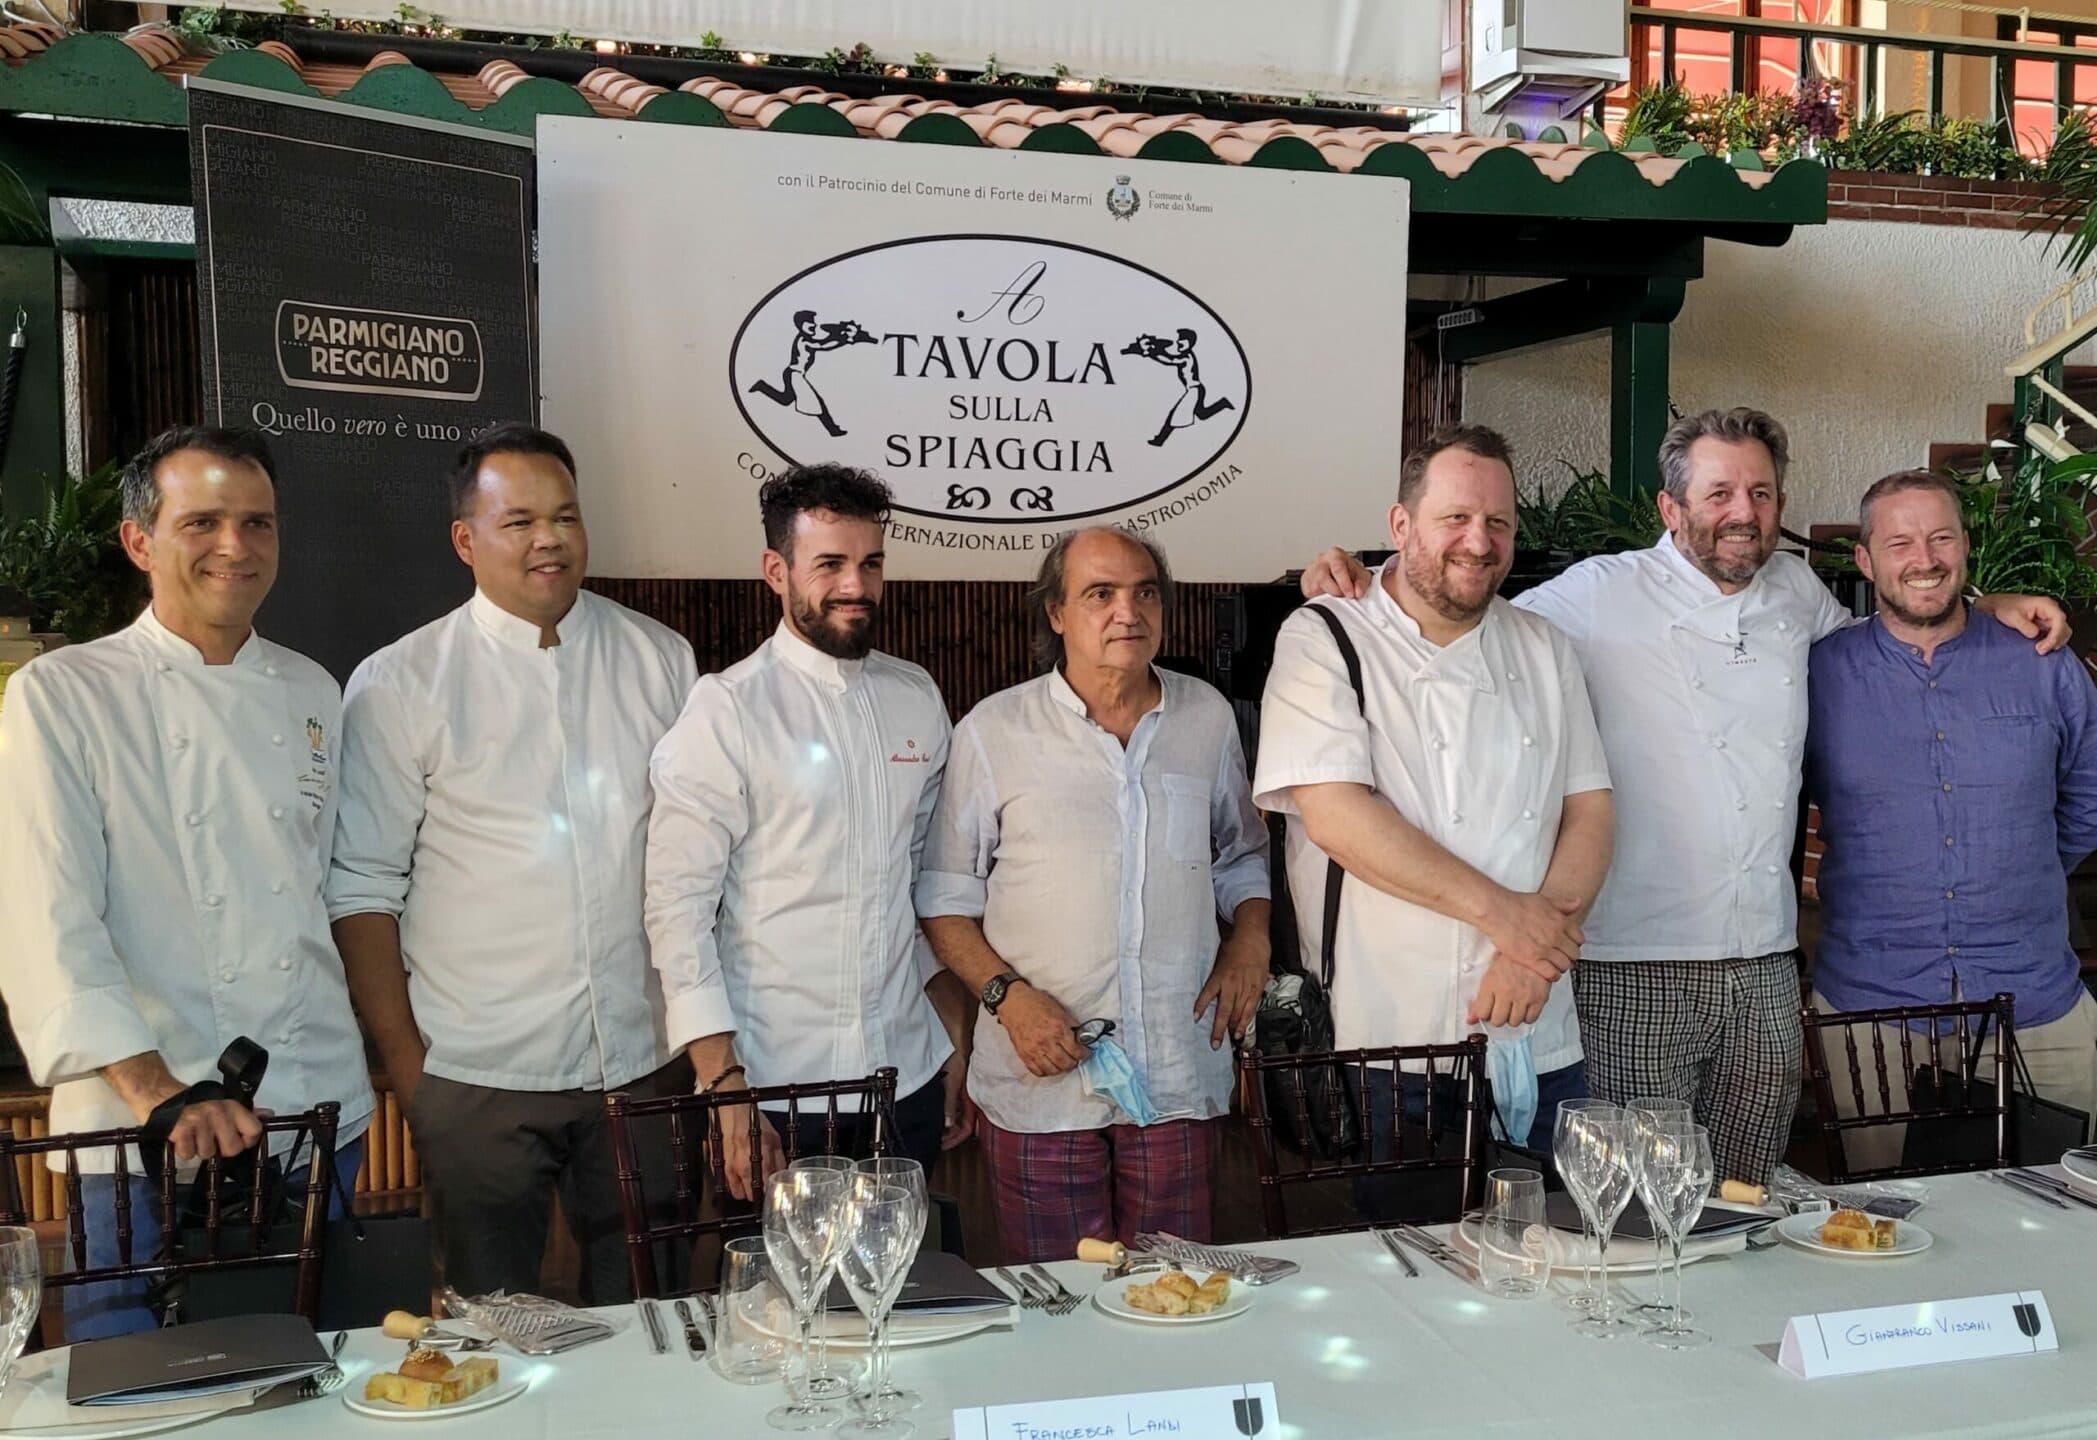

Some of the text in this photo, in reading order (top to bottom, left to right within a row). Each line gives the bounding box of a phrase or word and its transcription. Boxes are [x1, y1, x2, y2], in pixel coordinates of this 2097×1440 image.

[776, 174, 1093, 207] con il Patrocinio del Comune di Forte dei Marmi
[1148, 189, 1193, 201] Comune di
[1148, 200, 1214, 214] Forte dei Marmi
[956, 260, 1048, 326] A
[293, 313, 465, 356] PARMIGIANO
[311, 346, 450, 384] REGGIANO
[881, 332, 1117, 386] TAVOLA
[251, 402, 336, 436] Quello
[343, 417, 388, 435] vero
[394, 413, 408, 438] è
[415, 421, 461, 442] uno
[948, 394, 1055, 423] SULLA
[885, 434, 1115, 474] SPIAGGIA
[880, 518, 1035, 551] TERNAZIONALE
[1111, 463, 1244, 537] GASTRONOMIA
[1934, 1316, 1992, 1333] VISSANI
